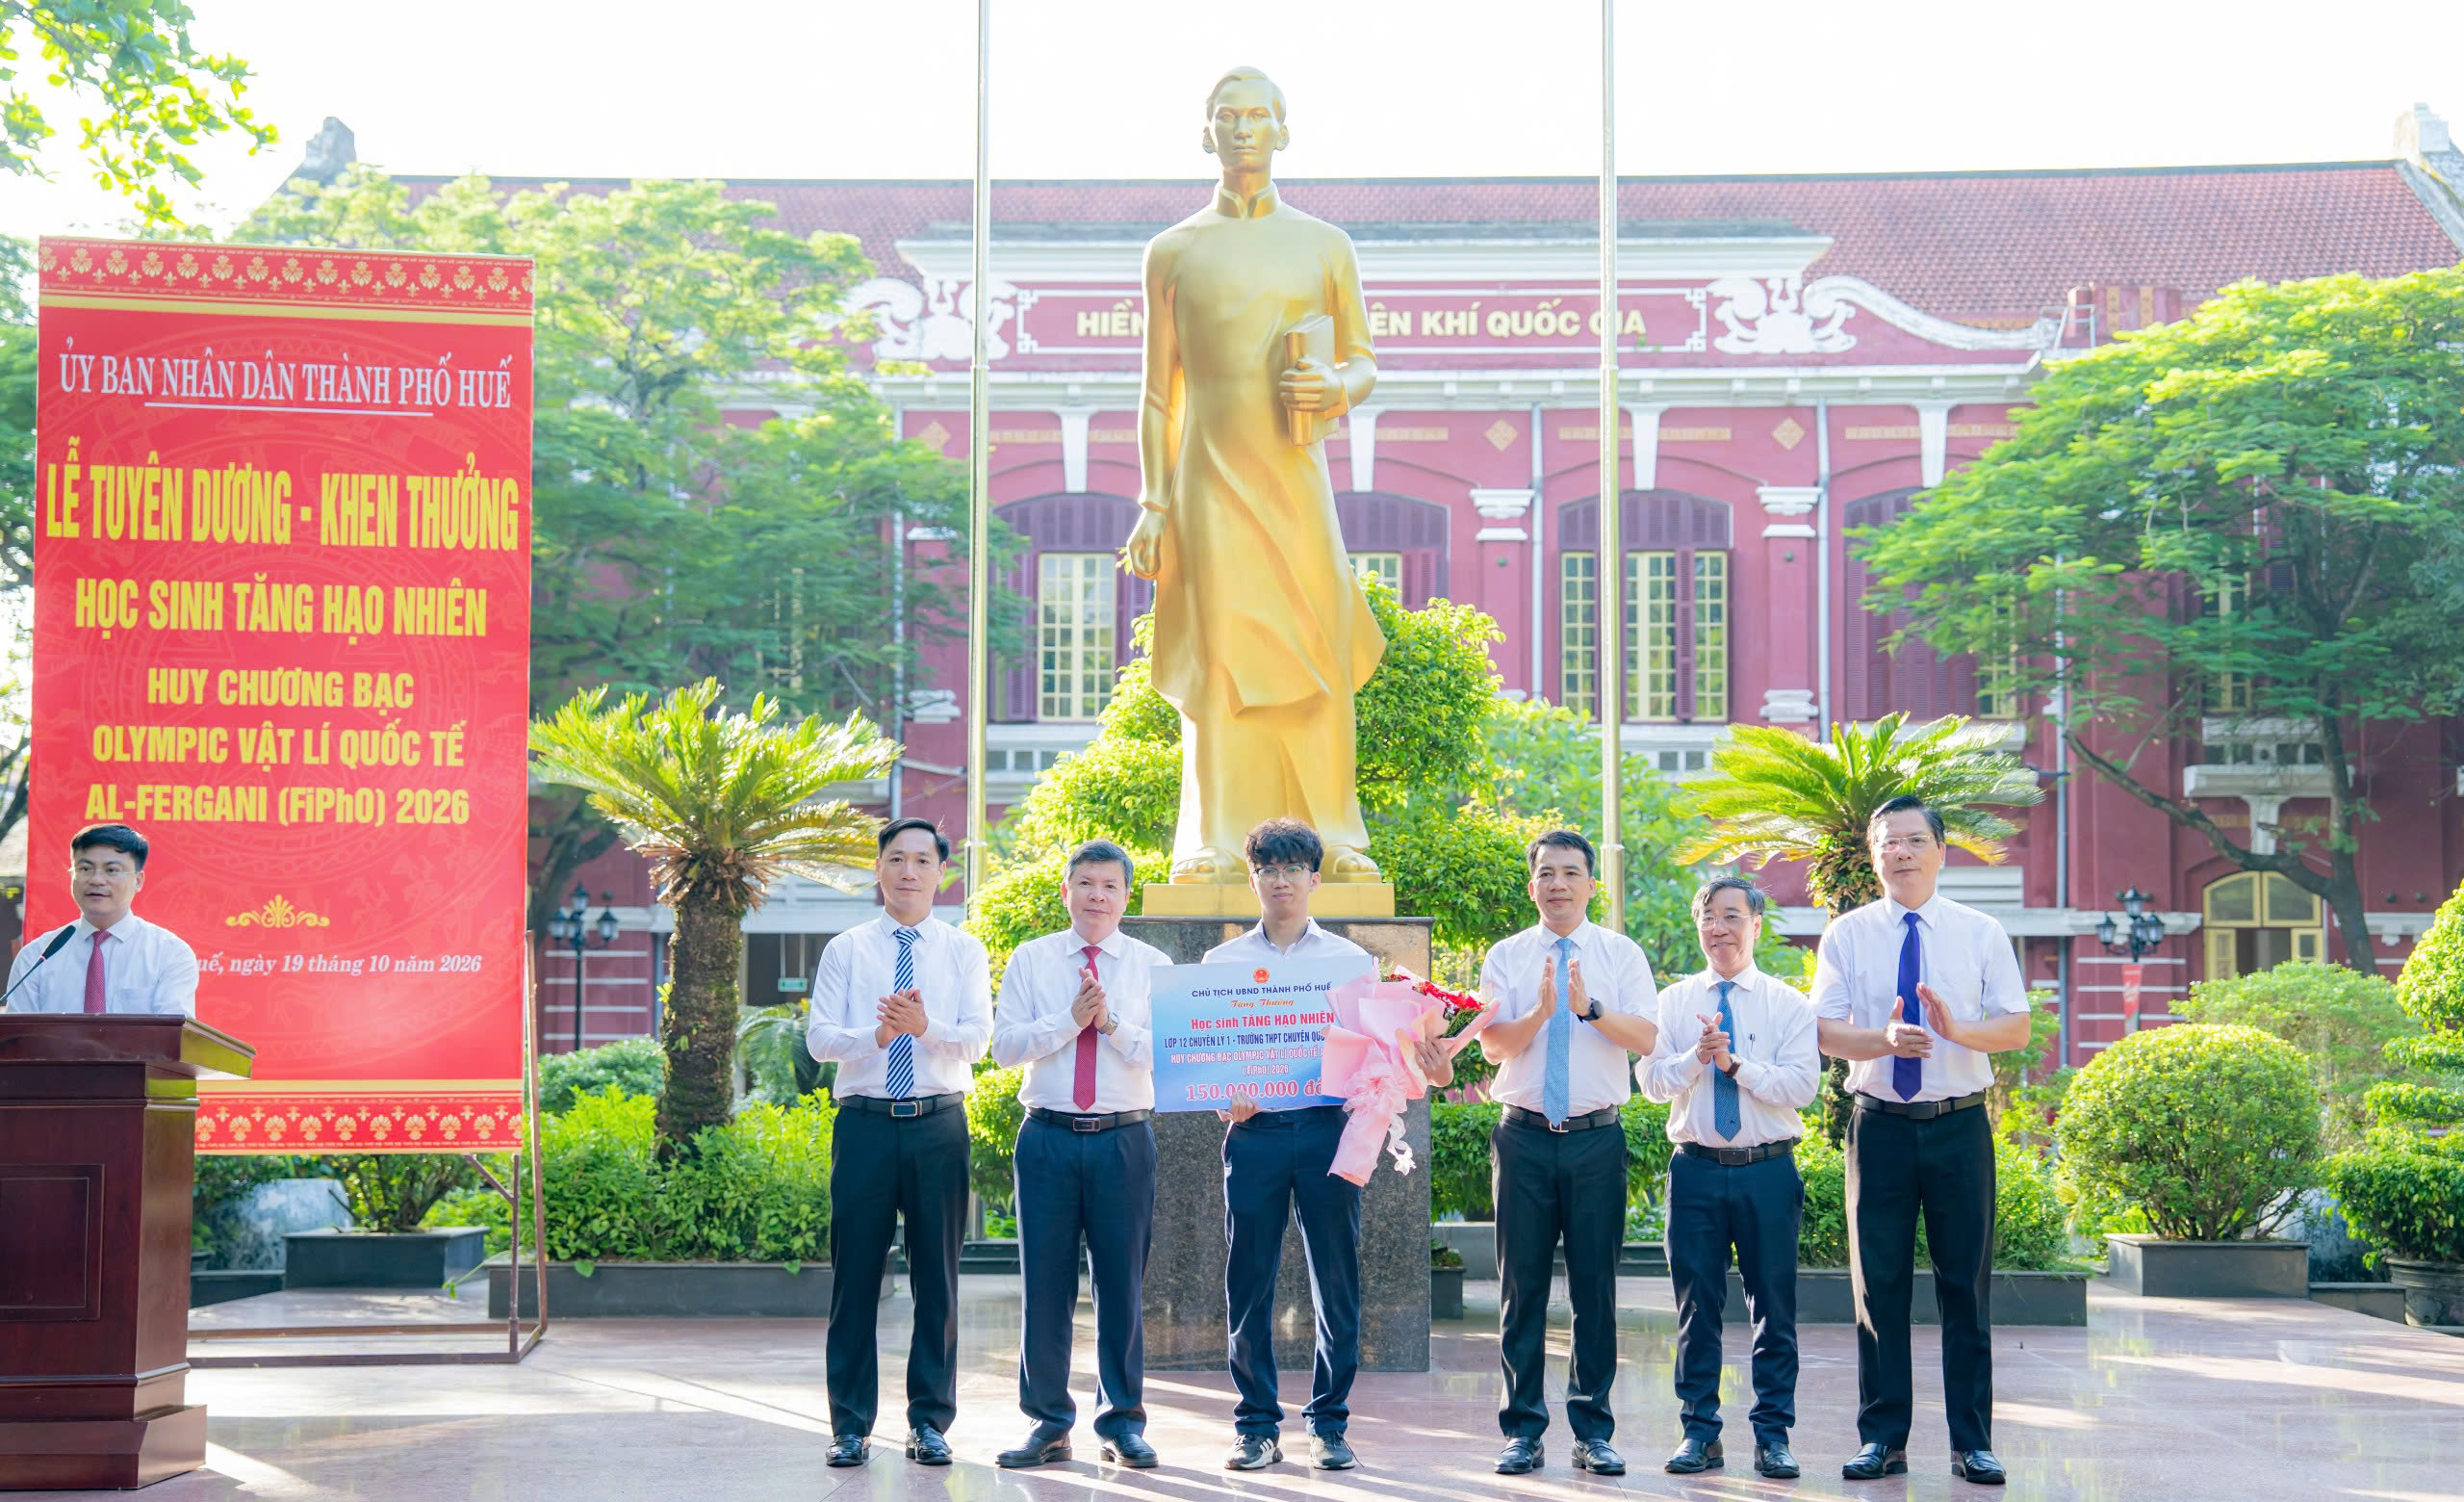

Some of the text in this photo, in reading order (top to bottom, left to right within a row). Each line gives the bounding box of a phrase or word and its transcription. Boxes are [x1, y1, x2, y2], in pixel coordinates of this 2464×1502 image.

[1421, 300, 1481, 337] KHÍ
[1485, 298, 1581, 339] QUỐC
[60, 336, 513, 408] ỦY BAN NHÂN DÂN THÀNH PHỐ HUẾ
[46, 436, 81, 538] LỄ
[90, 450, 184, 541] TUYÊN
[192, 461, 292, 545] DƯƠNG
[320, 473, 398, 548] KHEN
[405, 451, 519, 552] THƯỞNG
[75, 572, 487, 645] HỌC SINH TĂNG HẠO NHIÊN
[147, 666, 415, 716] HUY CHƯƠNG BẠC
[92, 718, 468, 772] OLYMPIC VẬT LÍ QUỐC TẾ
[84, 784, 471, 828] AL-FERGANI (FiPhO) 2026
[195, 950, 483, 977] uế, ngày 19 tháng 10 năm 2026
[1192, 980, 1332, 998] CHỦ TỊCH UBND THÀNH PHỐ HUẾ
[1179, 1037, 1188, 1049] 12
[1189, 1034, 1216, 1048] CHUYÊN
[1226, 1035, 1230, 1046] 1
[1237, 1031, 1264, 1046] TRƯỜNG
[1265, 1032, 1281, 1045] THPT
[1283, 1029, 1310, 1043] CHUYÊN
[1191, 1010, 1335, 1032] Học sinh TĂNG HẠO NHIÊN
[1170, 1053, 1185, 1064] HUY
[1233, 1049, 1264, 1061] OLYMPIC
[1271, 1063, 1289, 1075] 2026
